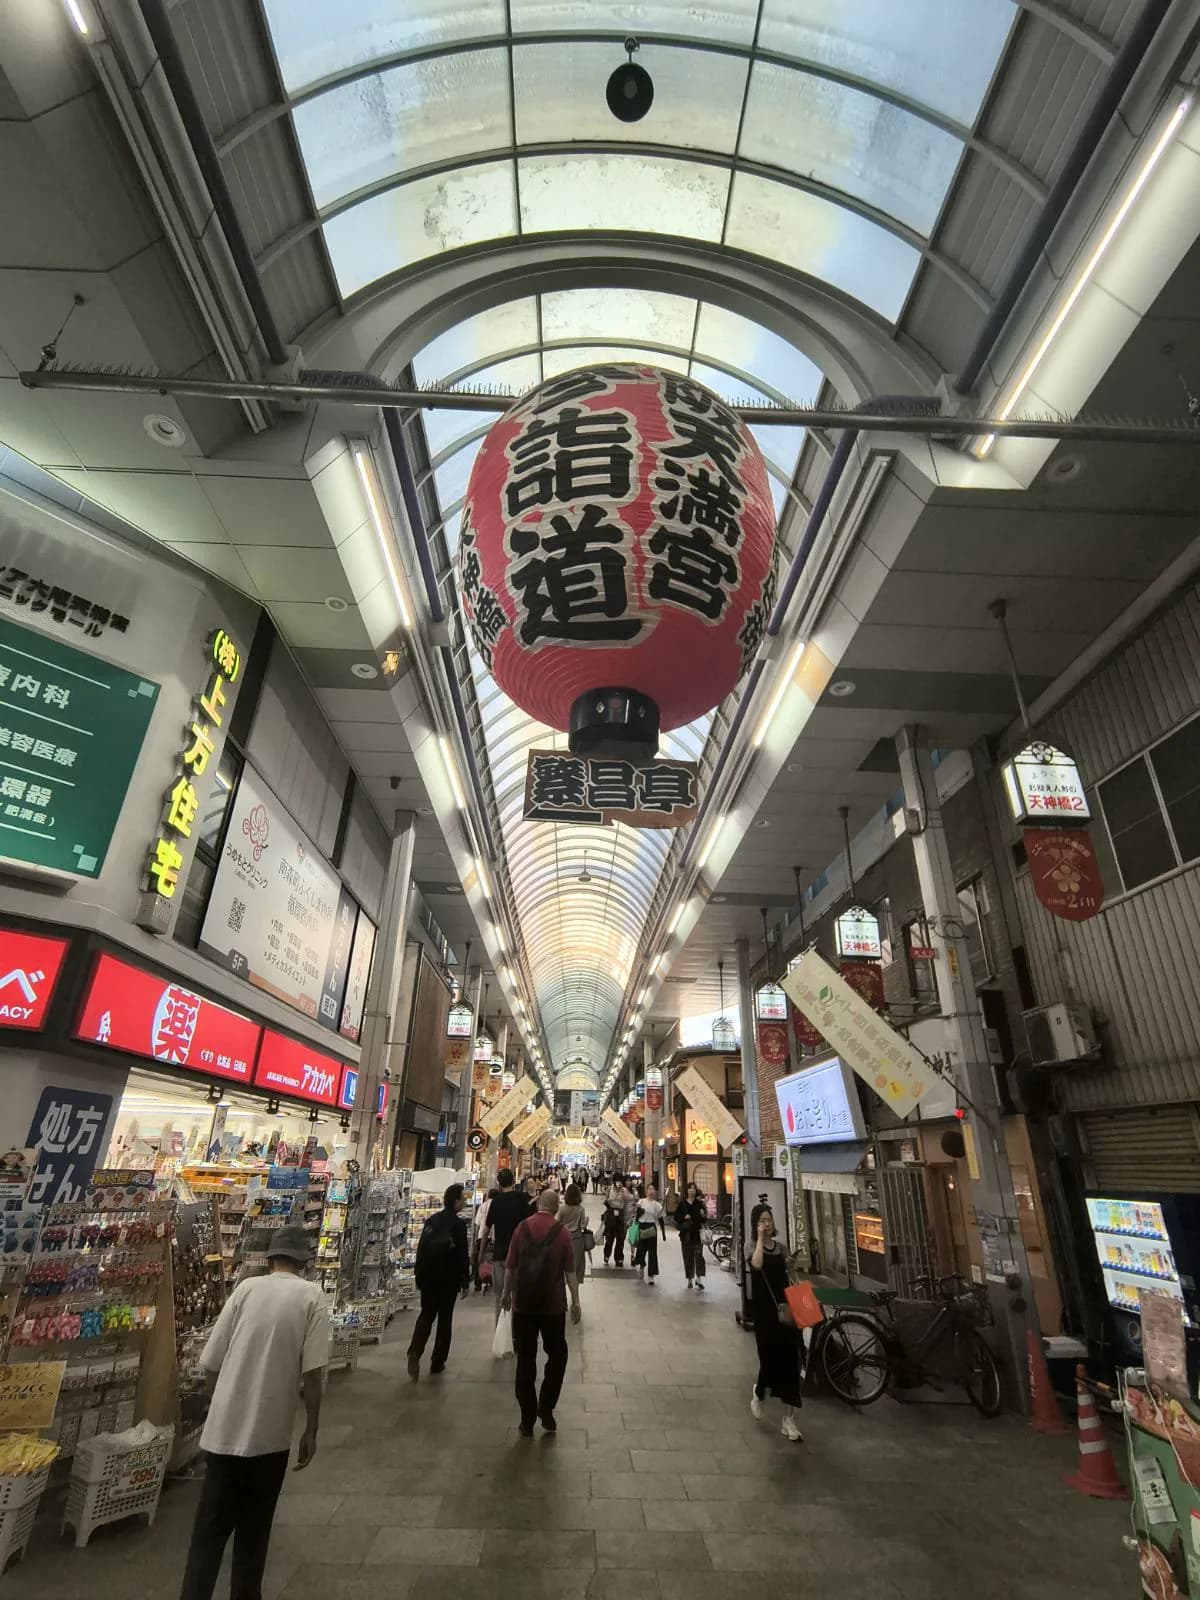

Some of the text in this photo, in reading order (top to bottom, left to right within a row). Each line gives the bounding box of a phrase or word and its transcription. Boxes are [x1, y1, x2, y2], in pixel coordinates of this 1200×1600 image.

[531, 756, 696, 814] 繁昌亭
[0, 802, 55, 827] 肥満症)
[1028, 794, 1085, 811] 天神橋2
[226, 843, 268, 889] うめもとクリニック
[843, 941, 878, 952] 天神橋2
[231, 955, 244, 970] 5F
[0, 1004, 34, 1020] ACY
[155, 985, 201, 1064] 薬
[200, 1049, 214, 1063] くすり
[301, 1063, 335, 1097] アカカベ
[34, 1101, 104, 1155] 処方
[25, 1163, 82, 1204] せん
